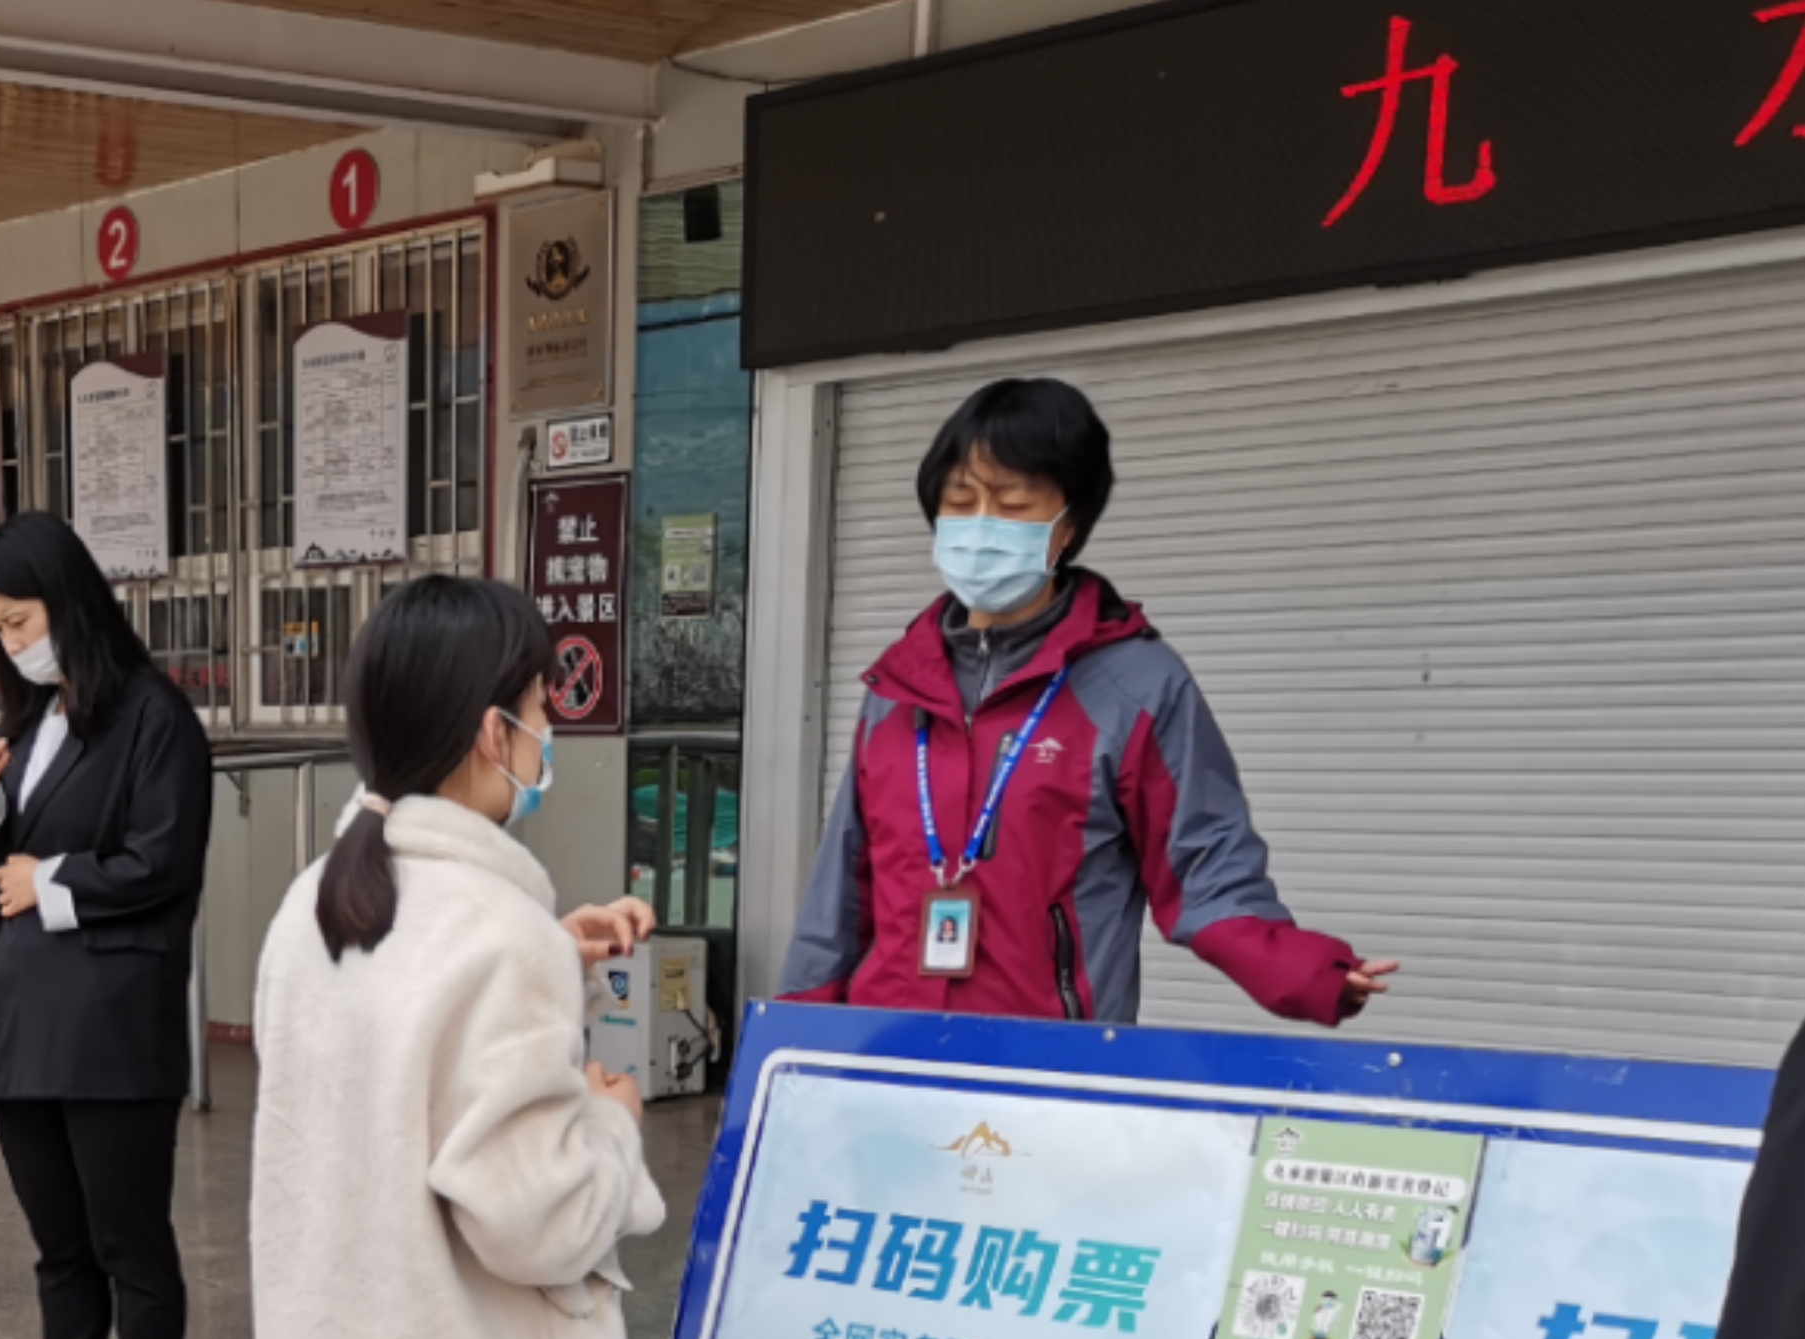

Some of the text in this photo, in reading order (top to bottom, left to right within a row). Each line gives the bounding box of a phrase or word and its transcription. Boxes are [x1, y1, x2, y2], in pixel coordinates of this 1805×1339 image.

[1320, 14, 1497, 229] 九
[342, 162, 358, 217] 1
[108, 219, 128, 270] 2
[557, 512, 600, 545] 禁止
[536, 592, 617, 625] 进入景区
[783, 1200, 1162, 1333] 扫码购票
